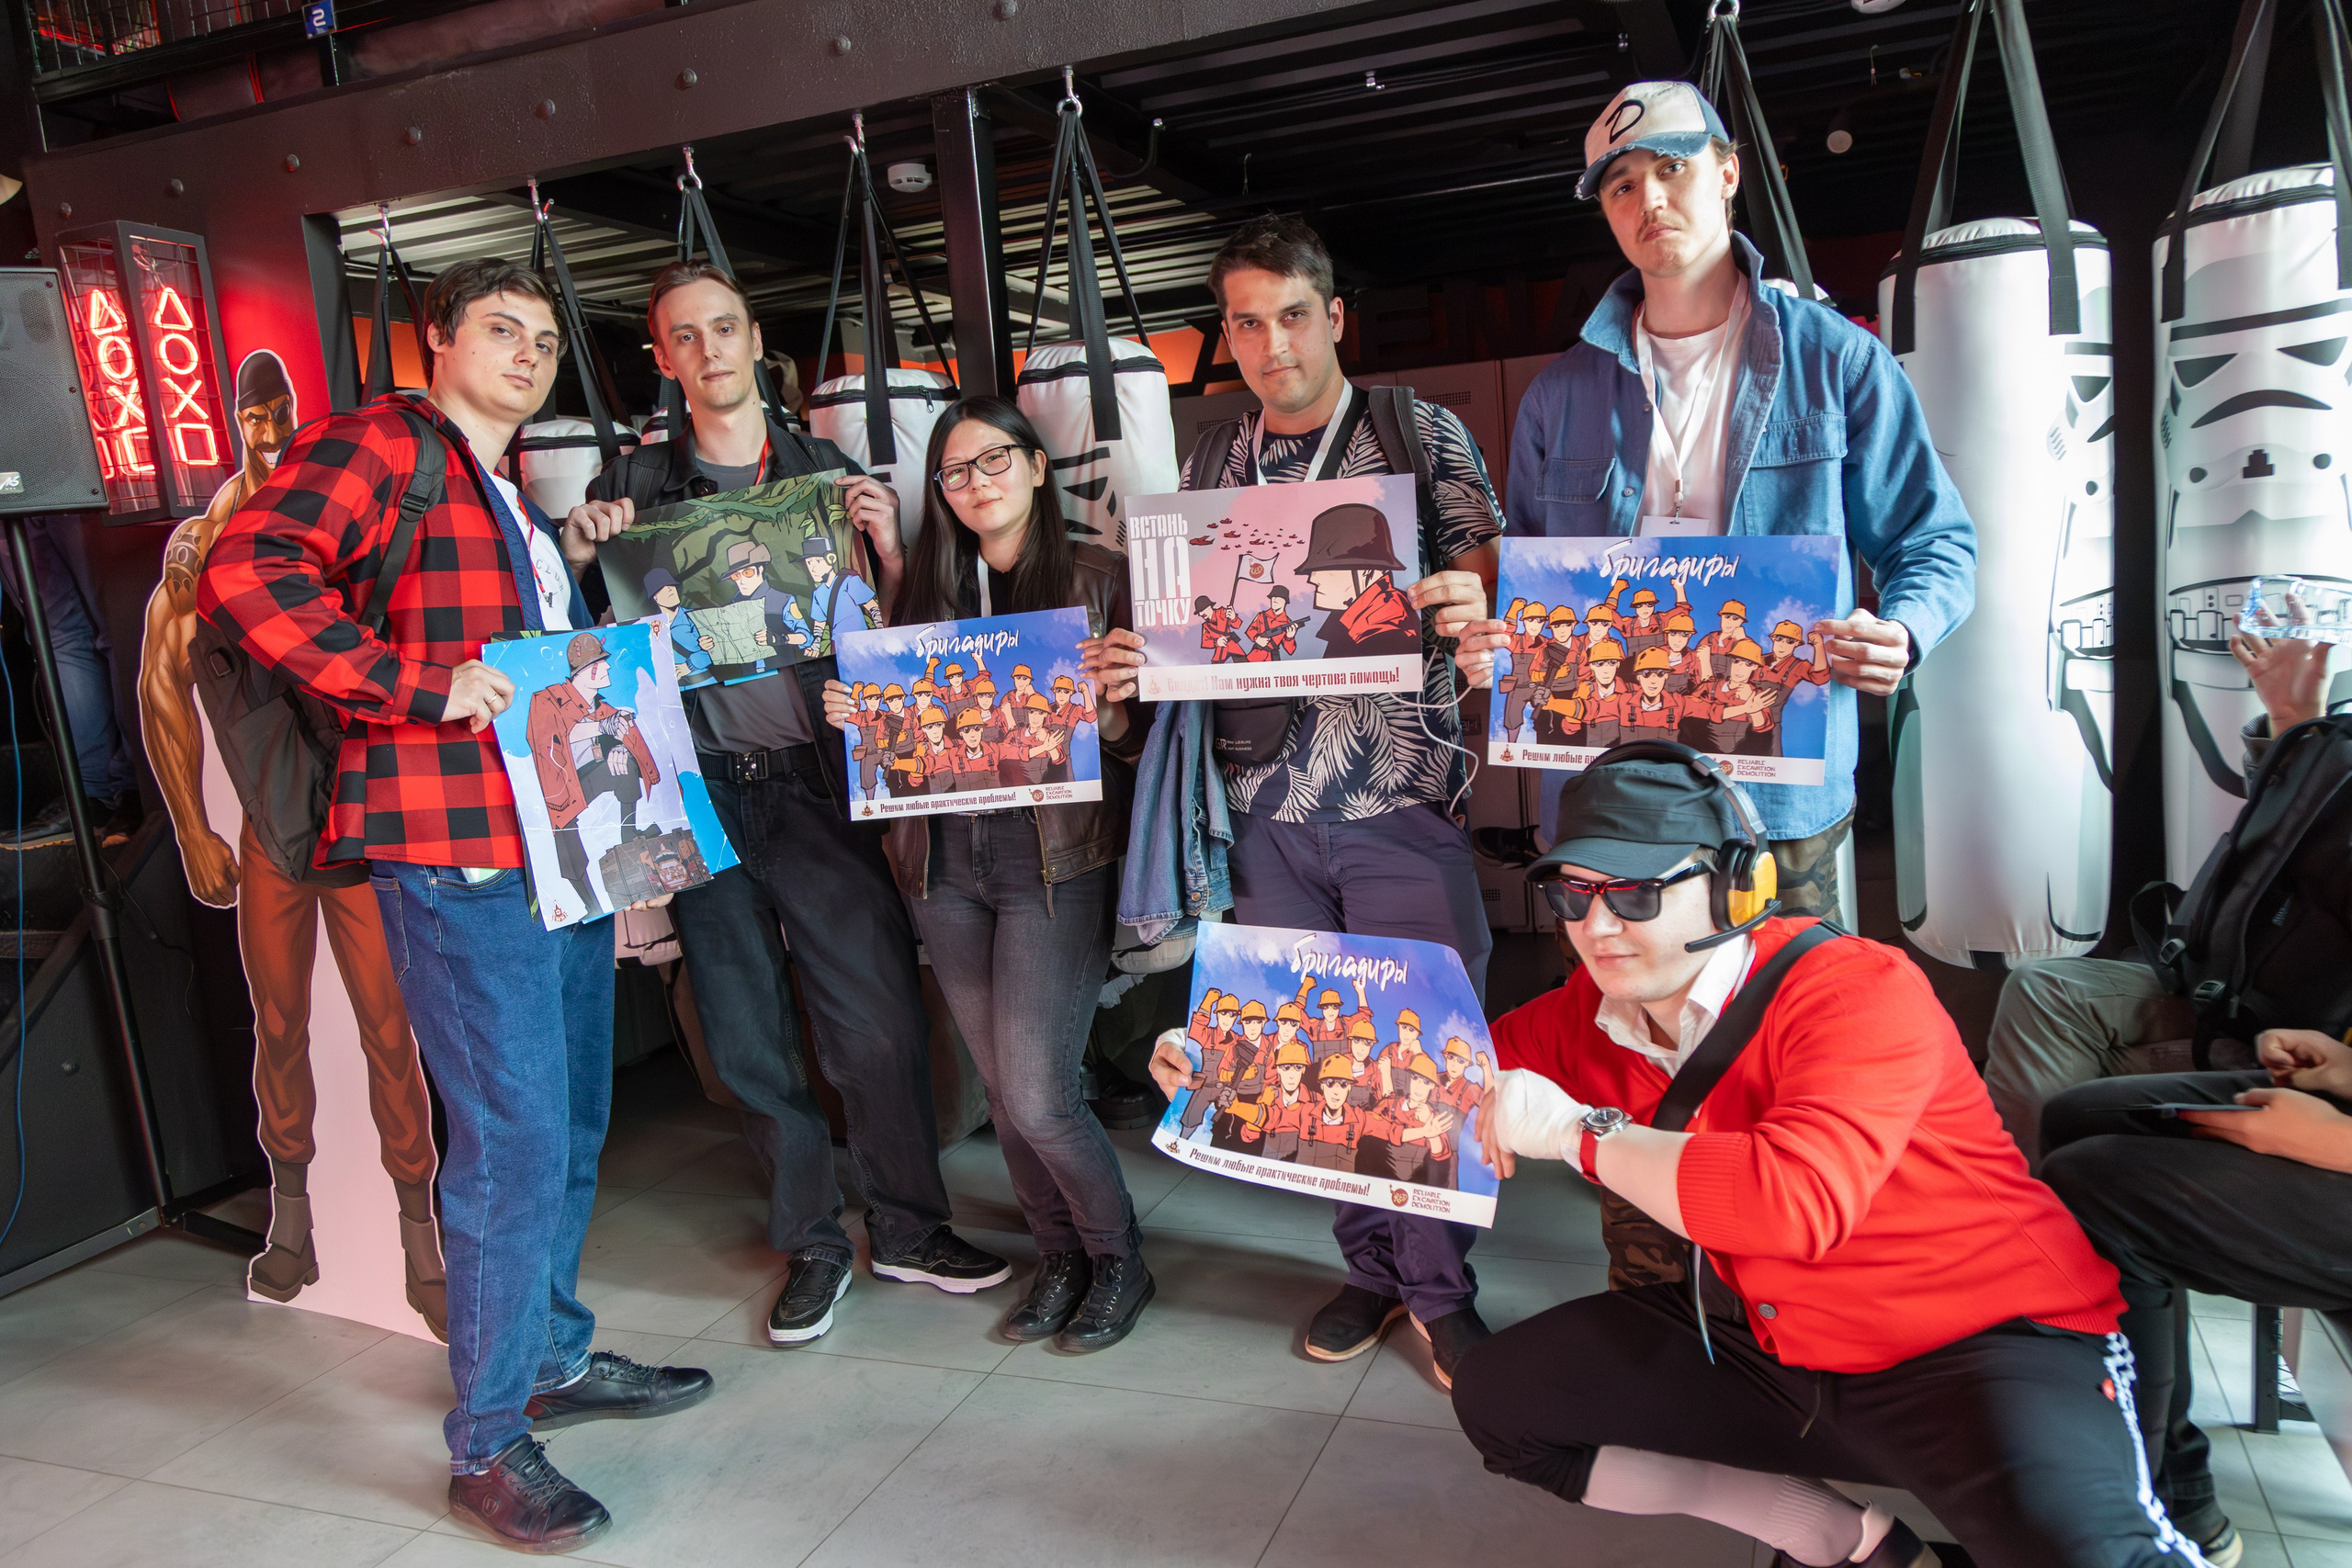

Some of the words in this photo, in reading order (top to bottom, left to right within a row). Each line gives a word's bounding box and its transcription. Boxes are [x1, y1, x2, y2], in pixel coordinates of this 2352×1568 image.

[311, 8, 326, 27] 2
[1605, 99, 1645, 144] D
[1129, 513, 1188, 539] ВСТАНЬ
[1131, 536, 1191, 600] НА
[1135, 598, 1191, 626] ТОЧКУ
[1211, 675, 1234, 691] Нам
[1236, 676, 1271, 692] нужна
[1273, 674, 1299, 688] твоя
[1302, 671, 1347, 689] чертова
[1350, 666, 1400, 685] помощь!
[1522, 749, 1551, 761] Решим
[1553, 751, 1583, 763] любые
[1737, 770, 1776, 778] DEMOLITION
[879, 803, 904, 813] Решим
[905, 800, 930, 811] любые
[931, 796, 978, 810] практические
[978, 791, 1017, 806] проблемы!
[1189, 1147, 1221, 1167] Решим
[1222, 1159, 1255, 1176] любые
[1255, 1166, 1318, 1187] практические
[1318, 1177, 1371, 1196] проблемы!
[1412, 1194, 1451, 1206] EXCAVATION
[1413, 1189, 1442, 1199] RELIABLE
[1411, 1201, 1451, 1213] DEMOLITION
